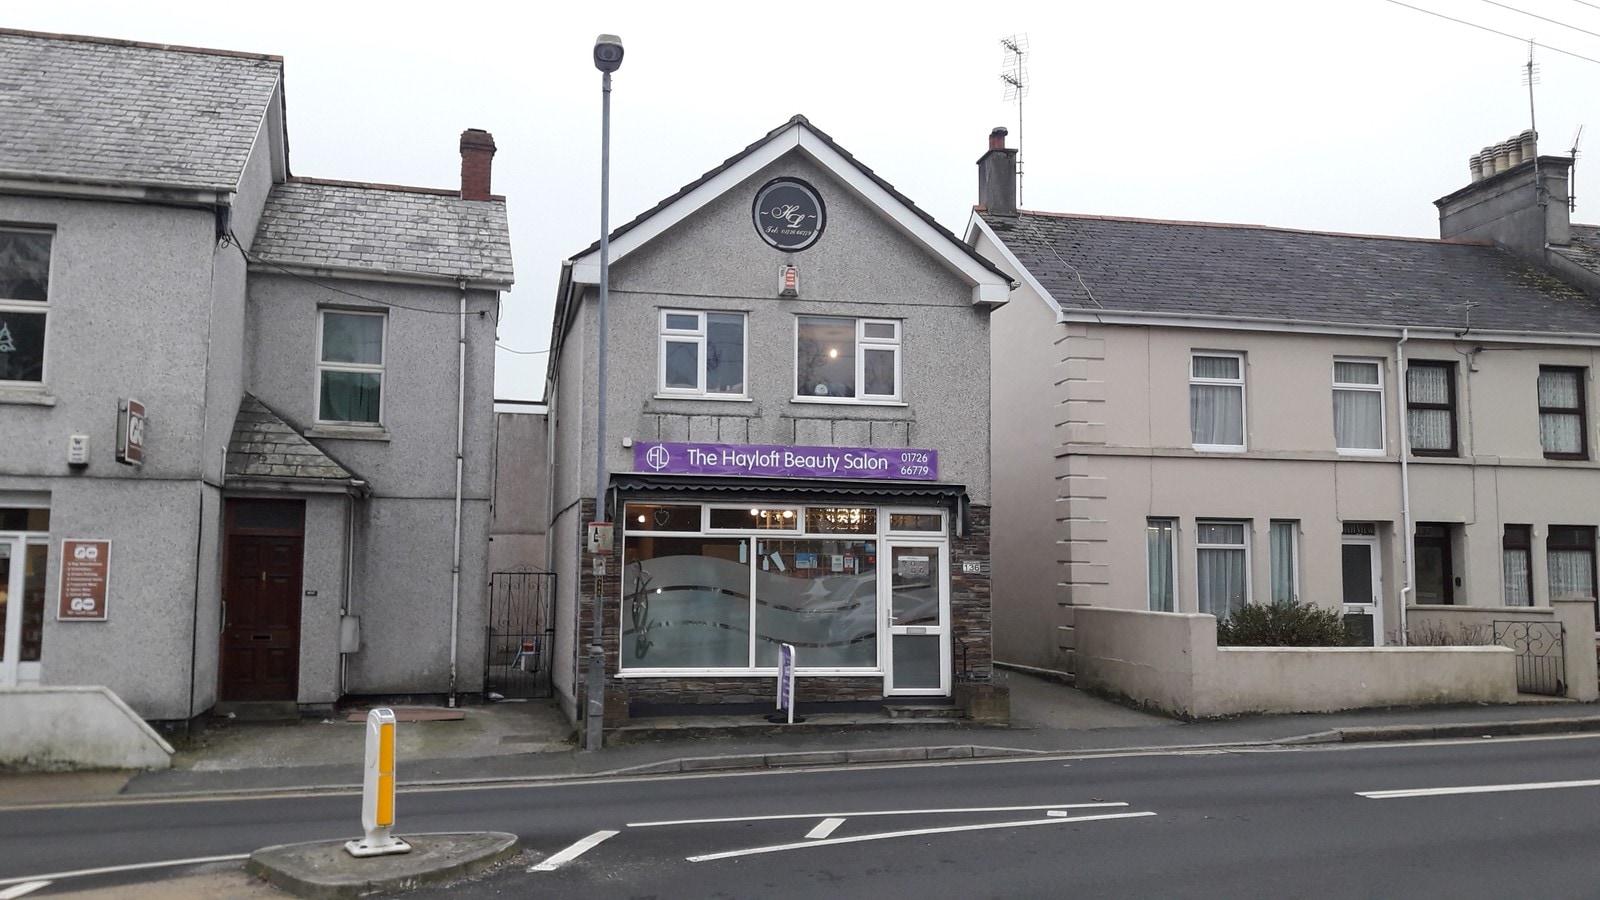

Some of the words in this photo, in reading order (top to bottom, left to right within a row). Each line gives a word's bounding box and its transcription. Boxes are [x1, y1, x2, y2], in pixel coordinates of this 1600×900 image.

[687, 449, 718, 466] The
[723, 450, 780, 471] Hayloft
[784, 451, 840, 473] Beauty
[843, 453, 888, 470] Salon
[901, 452, 928, 463] 01726
[901, 465, 929, 475] 66779
